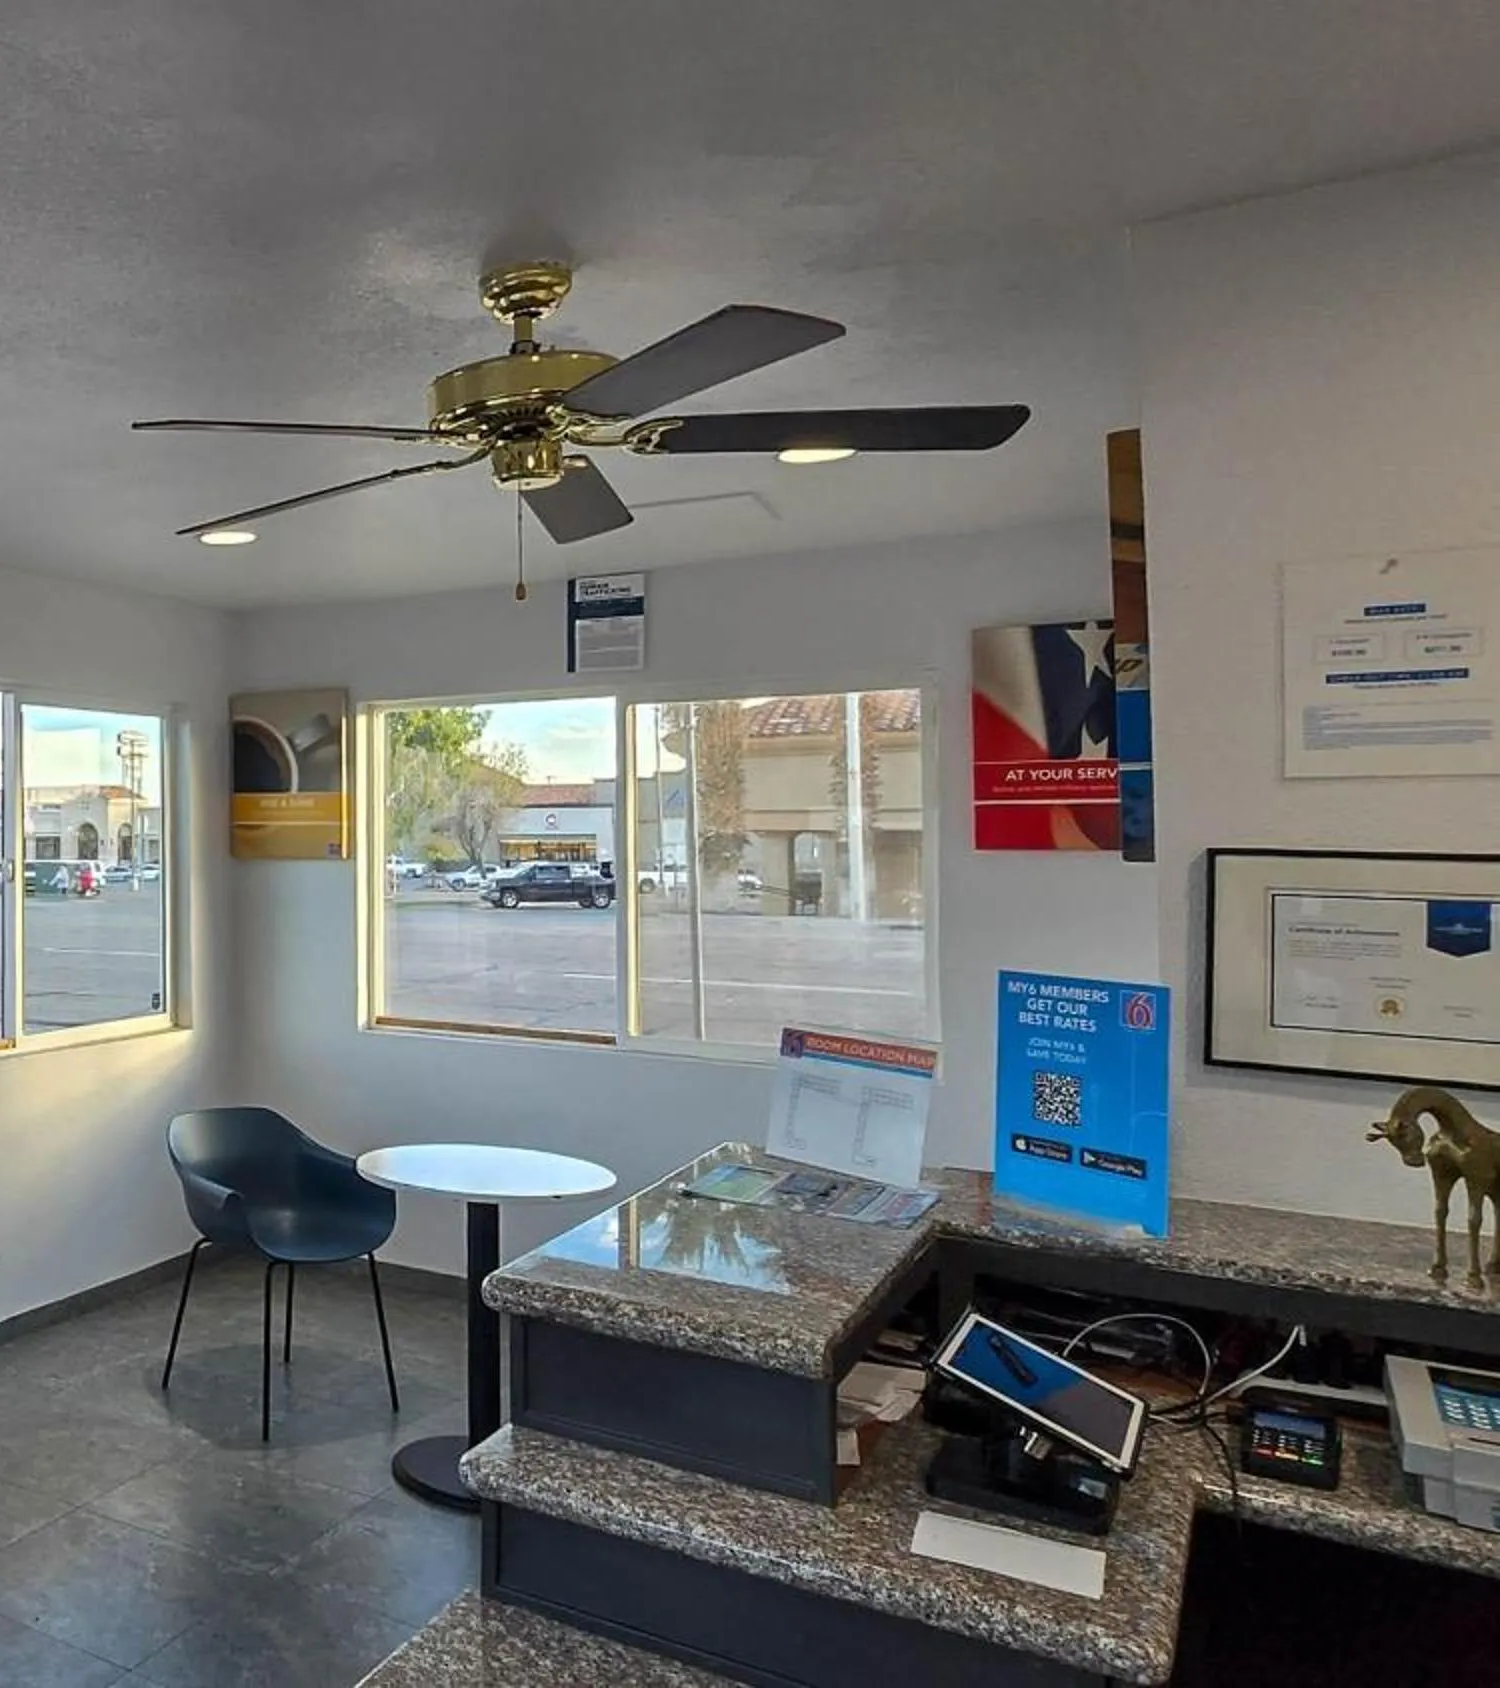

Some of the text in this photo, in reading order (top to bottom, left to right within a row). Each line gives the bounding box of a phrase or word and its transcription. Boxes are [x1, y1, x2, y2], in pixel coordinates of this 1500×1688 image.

[1005, 766, 1117, 782] AT YOUR SERV
[1007, 980, 1110, 1004] MY6 MEMBERS
[1027, 998, 1088, 1016] GET OUR
[1019, 1011, 1097, 1034] BEST RATES
[806, 1037, 842, 1051] ROOM
[843, 1043, 905, 1062] LOCATION
[1053, 1050, 1088, 1065] TODAY
